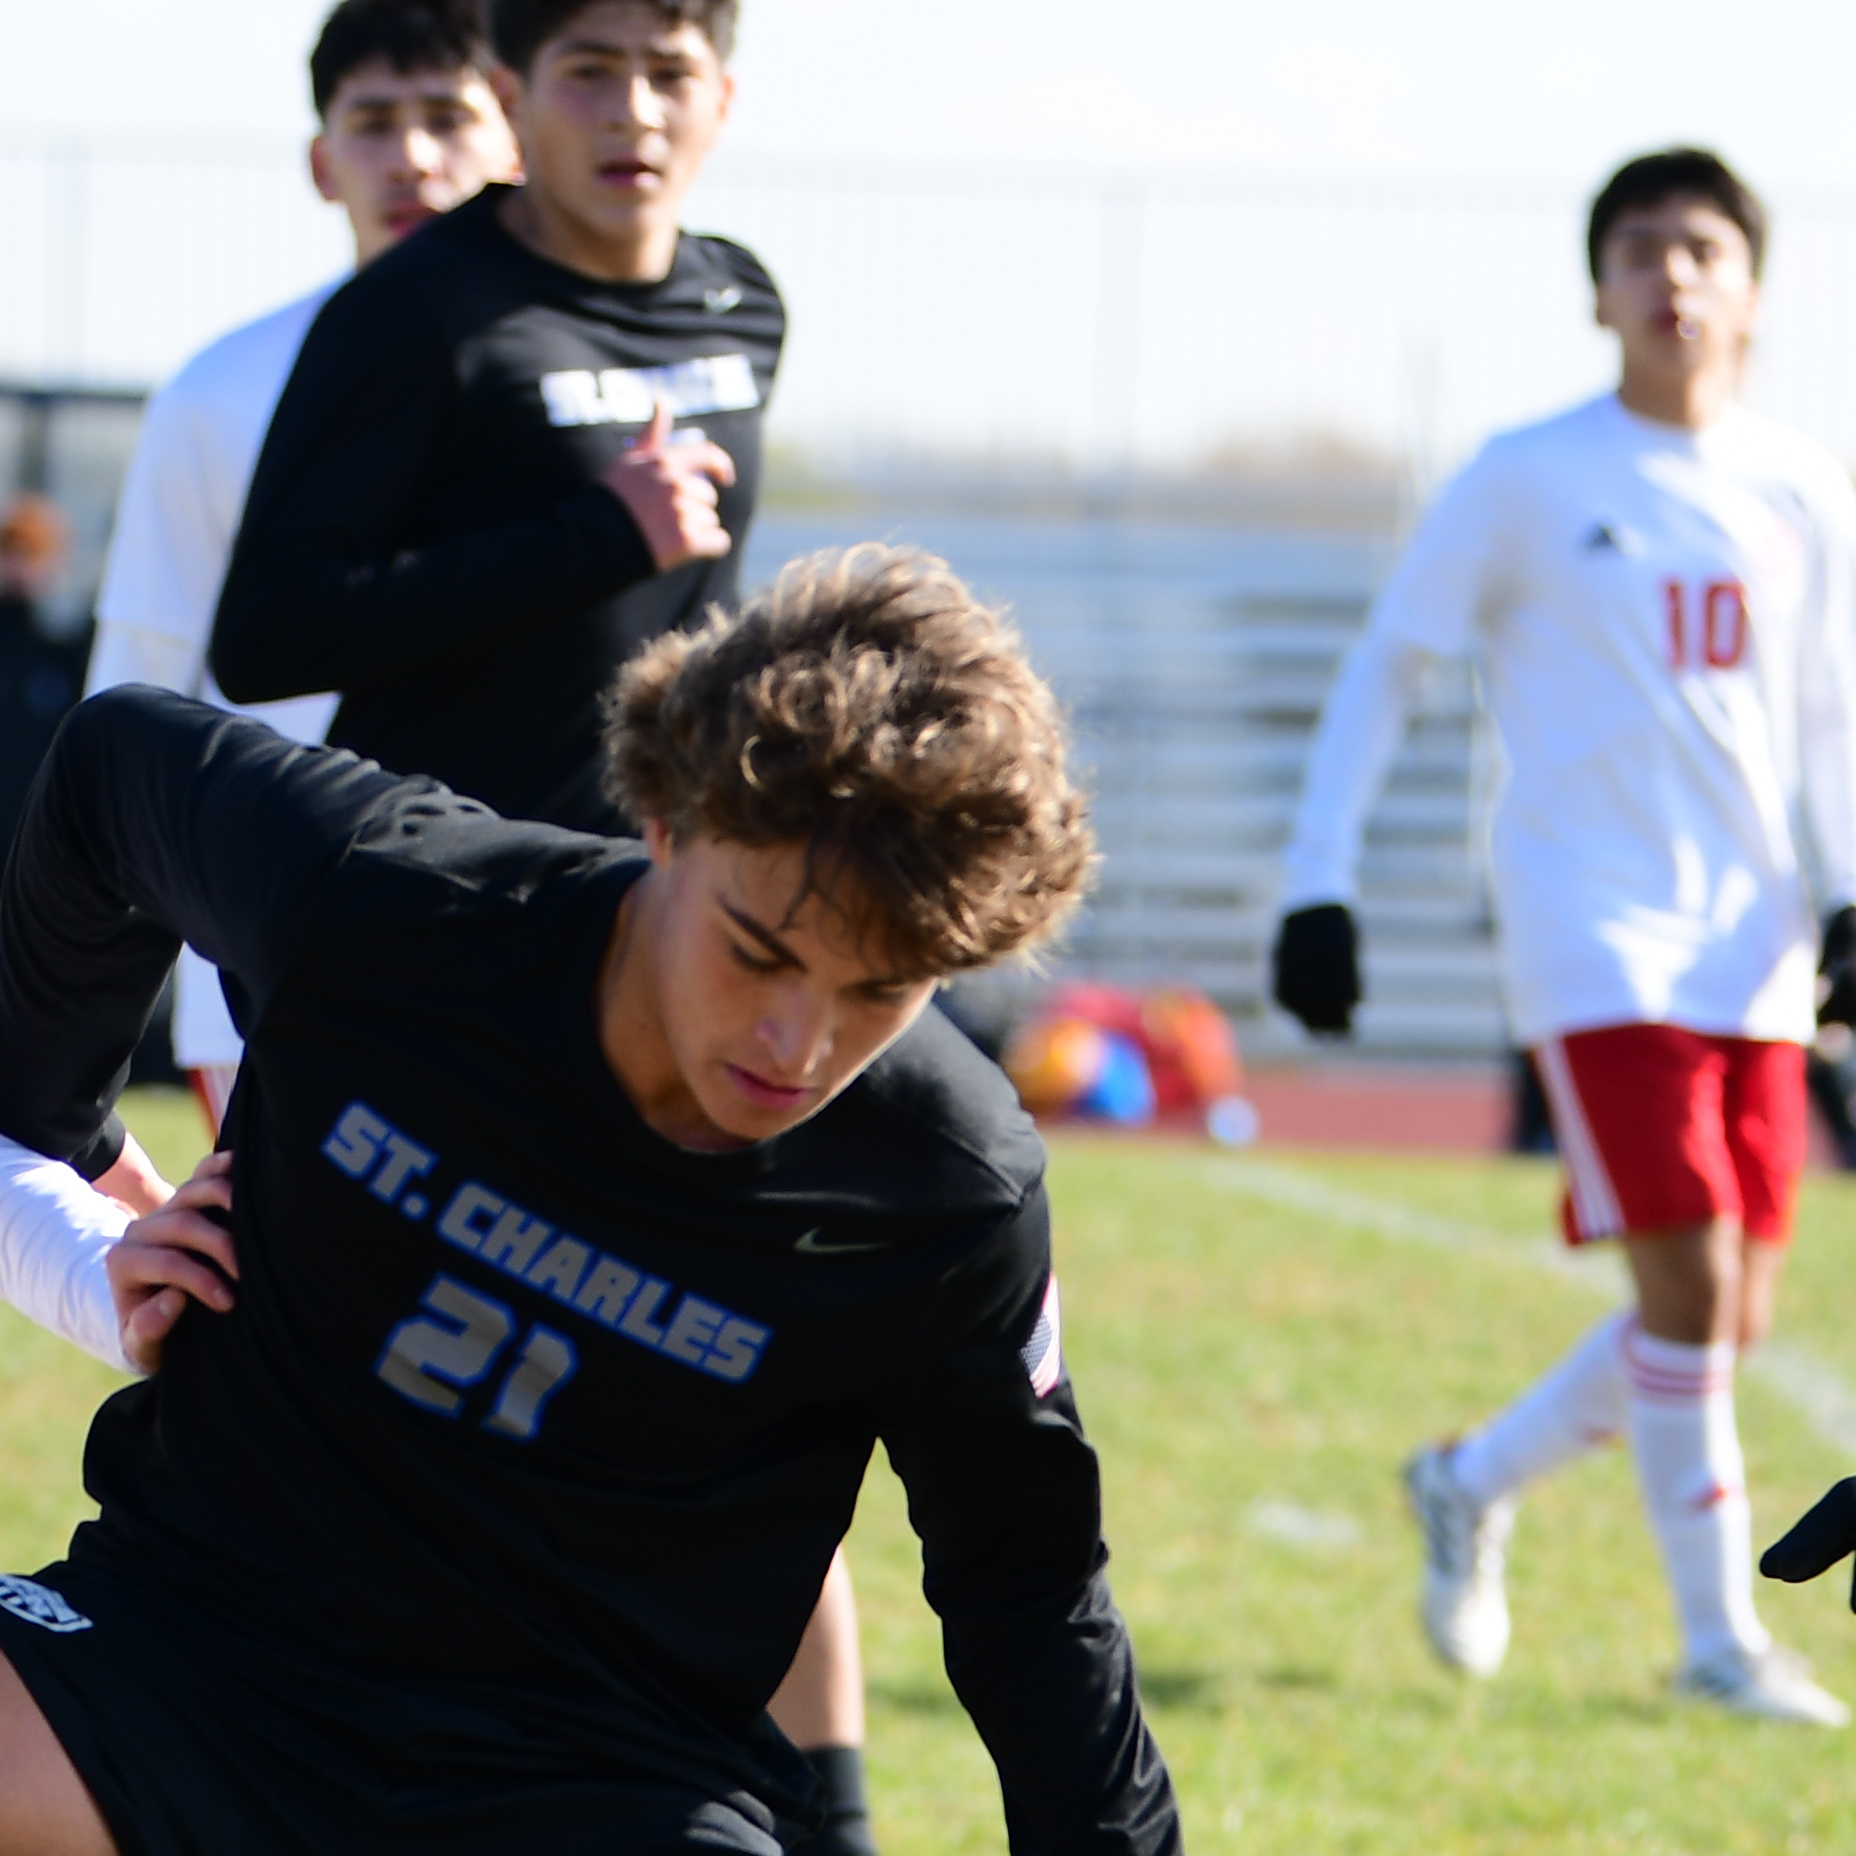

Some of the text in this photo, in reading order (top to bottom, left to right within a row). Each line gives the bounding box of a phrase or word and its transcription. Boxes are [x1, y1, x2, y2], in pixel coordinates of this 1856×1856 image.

[1662, 579, 1751, 674] 10
[320, 1101, 775, 1385] ST. CHARLES
[372, 1271, 581, 1445] 21
